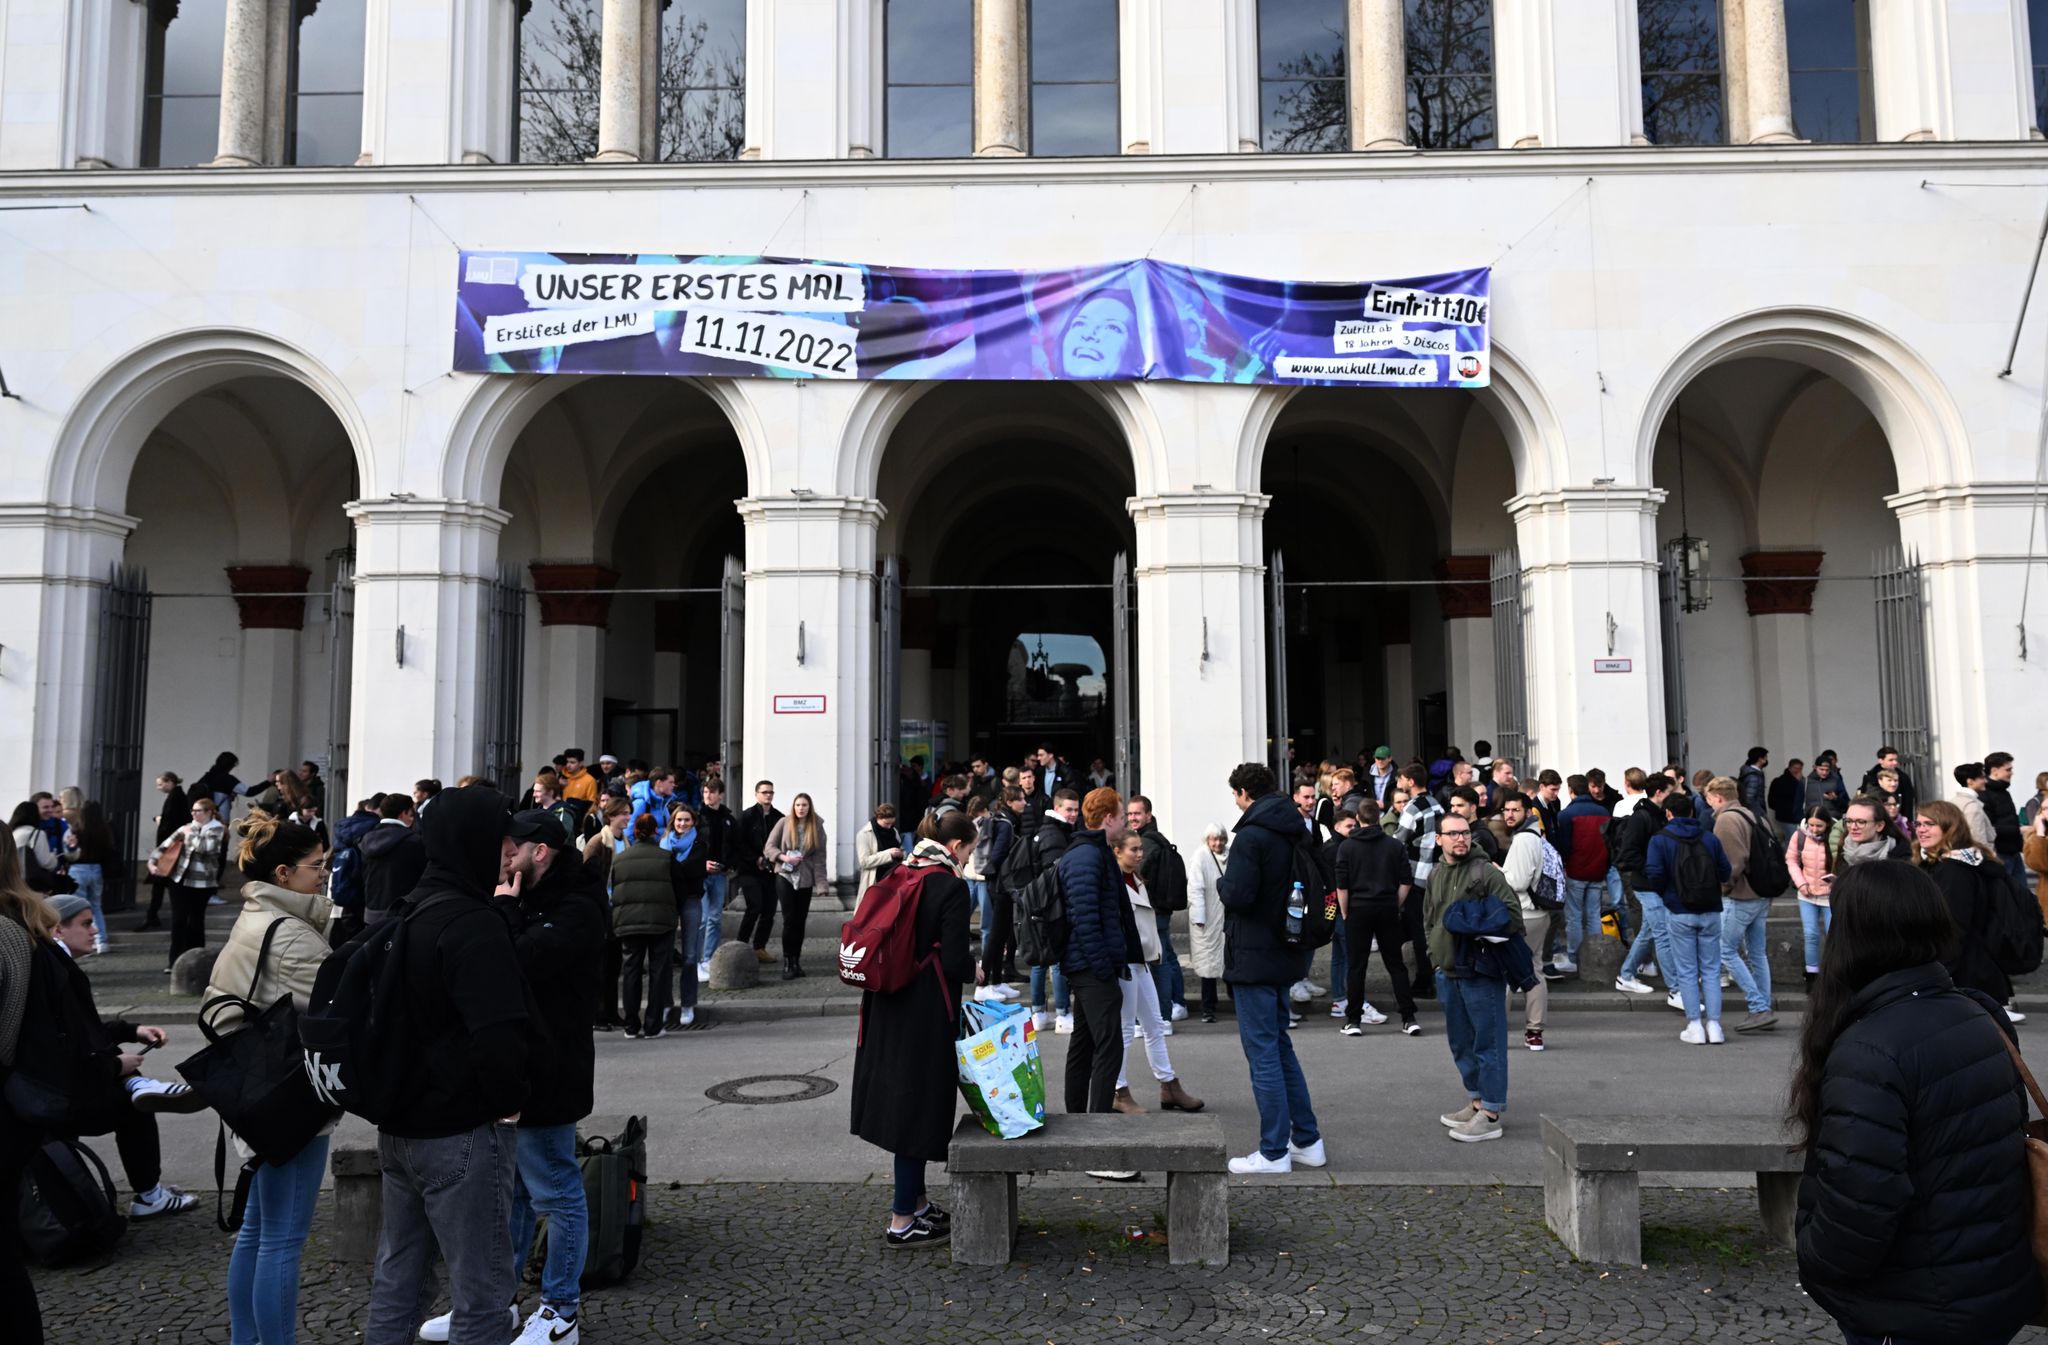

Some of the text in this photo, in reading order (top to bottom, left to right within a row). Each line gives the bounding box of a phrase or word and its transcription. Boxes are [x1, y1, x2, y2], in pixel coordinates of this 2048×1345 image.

[536, 273, 853, 301] UNSER ERSTES MAL
[497, 313, 637, 342] Erstifest der LMU
[1340, 324, 1392, 335] Zutritt ab
[694, 315, 853, 373] 11.11.2022
[1345, 340, 1354, 349] 18
[1402, 336, 1450, 351] 3 Discos
[1291, 362, 1425, 376] www.unikult.lmu.de
